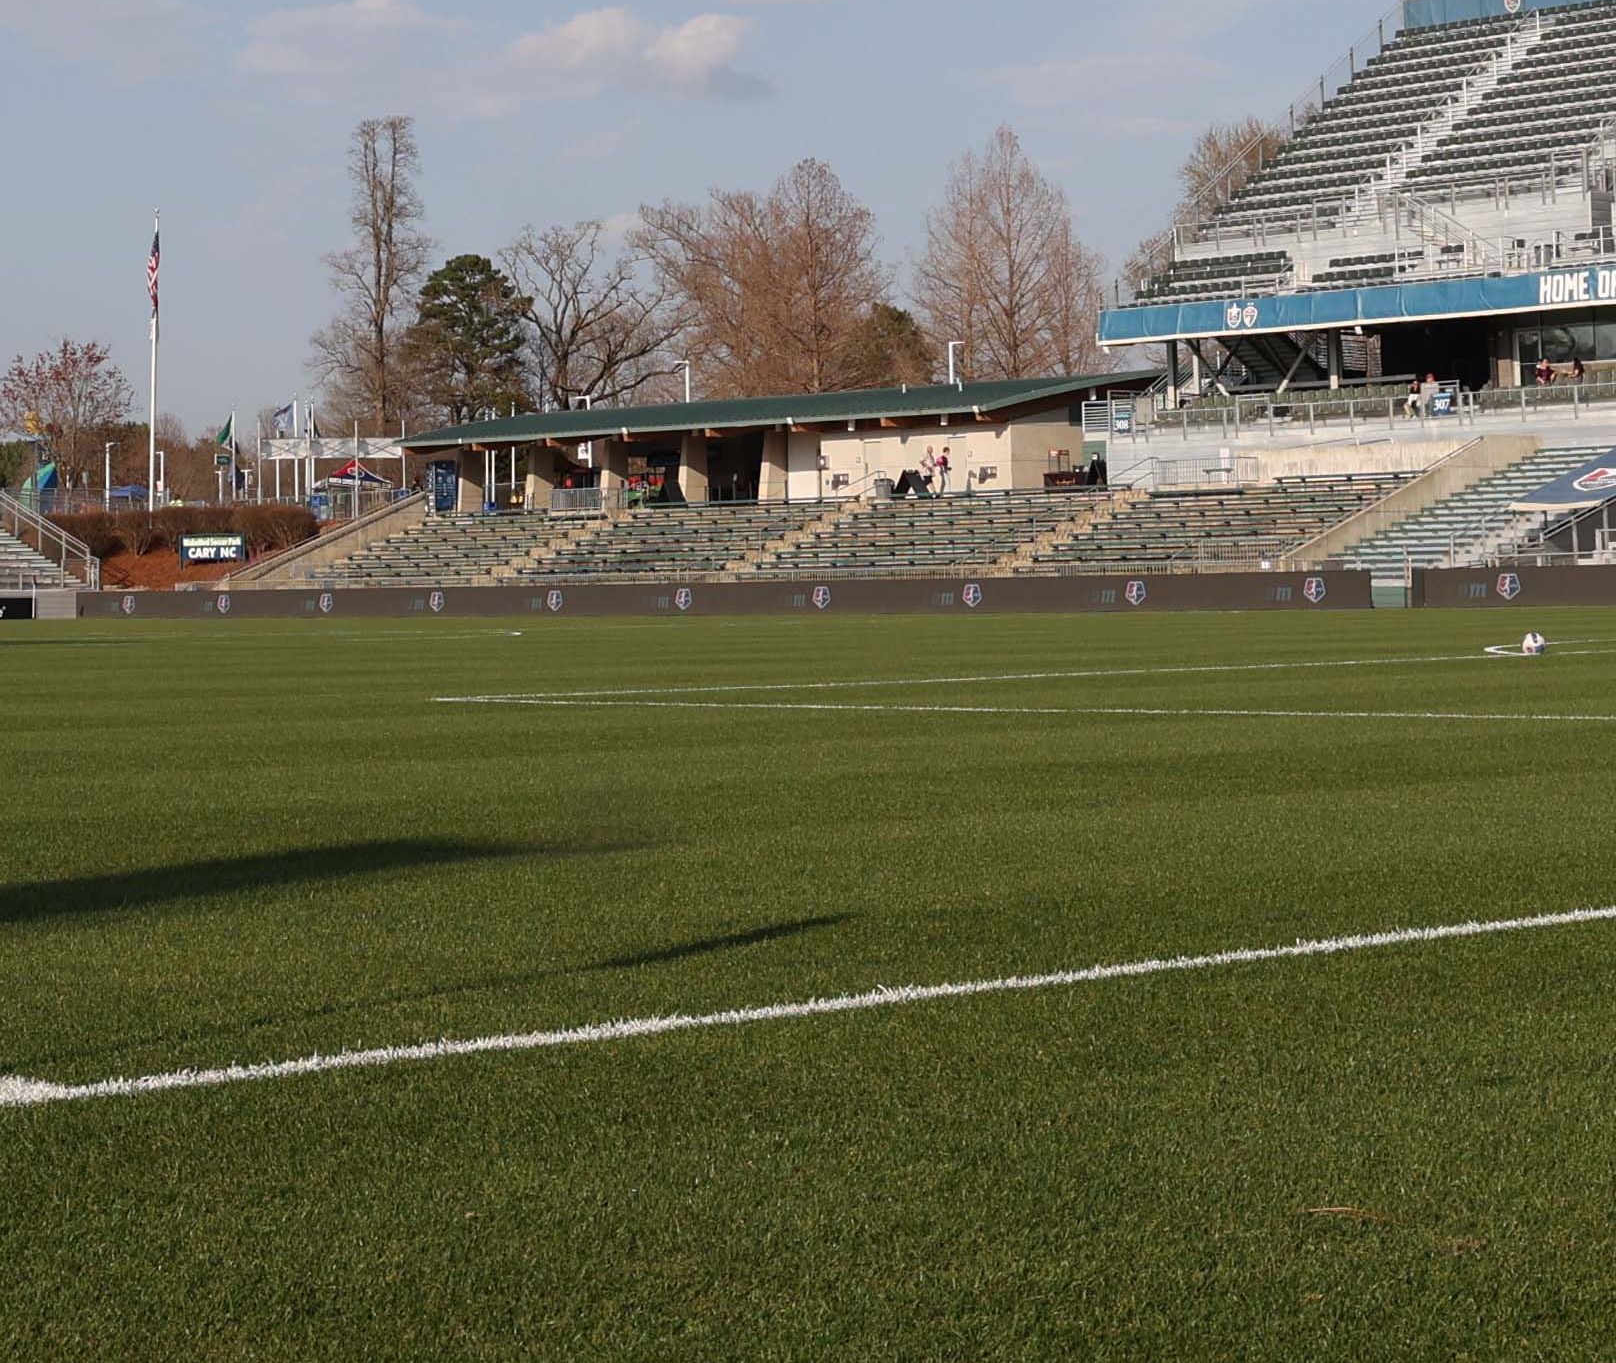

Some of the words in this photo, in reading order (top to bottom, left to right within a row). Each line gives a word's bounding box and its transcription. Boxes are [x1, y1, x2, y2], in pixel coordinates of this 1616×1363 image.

[1539, 271, 1590, 304] HOME
[1433, 399, 1450, 411] 307
[1113, 419, 1129, 430] 308
[188, 547, 216, 559] CARY
[220, 547, 236, 558] NC
